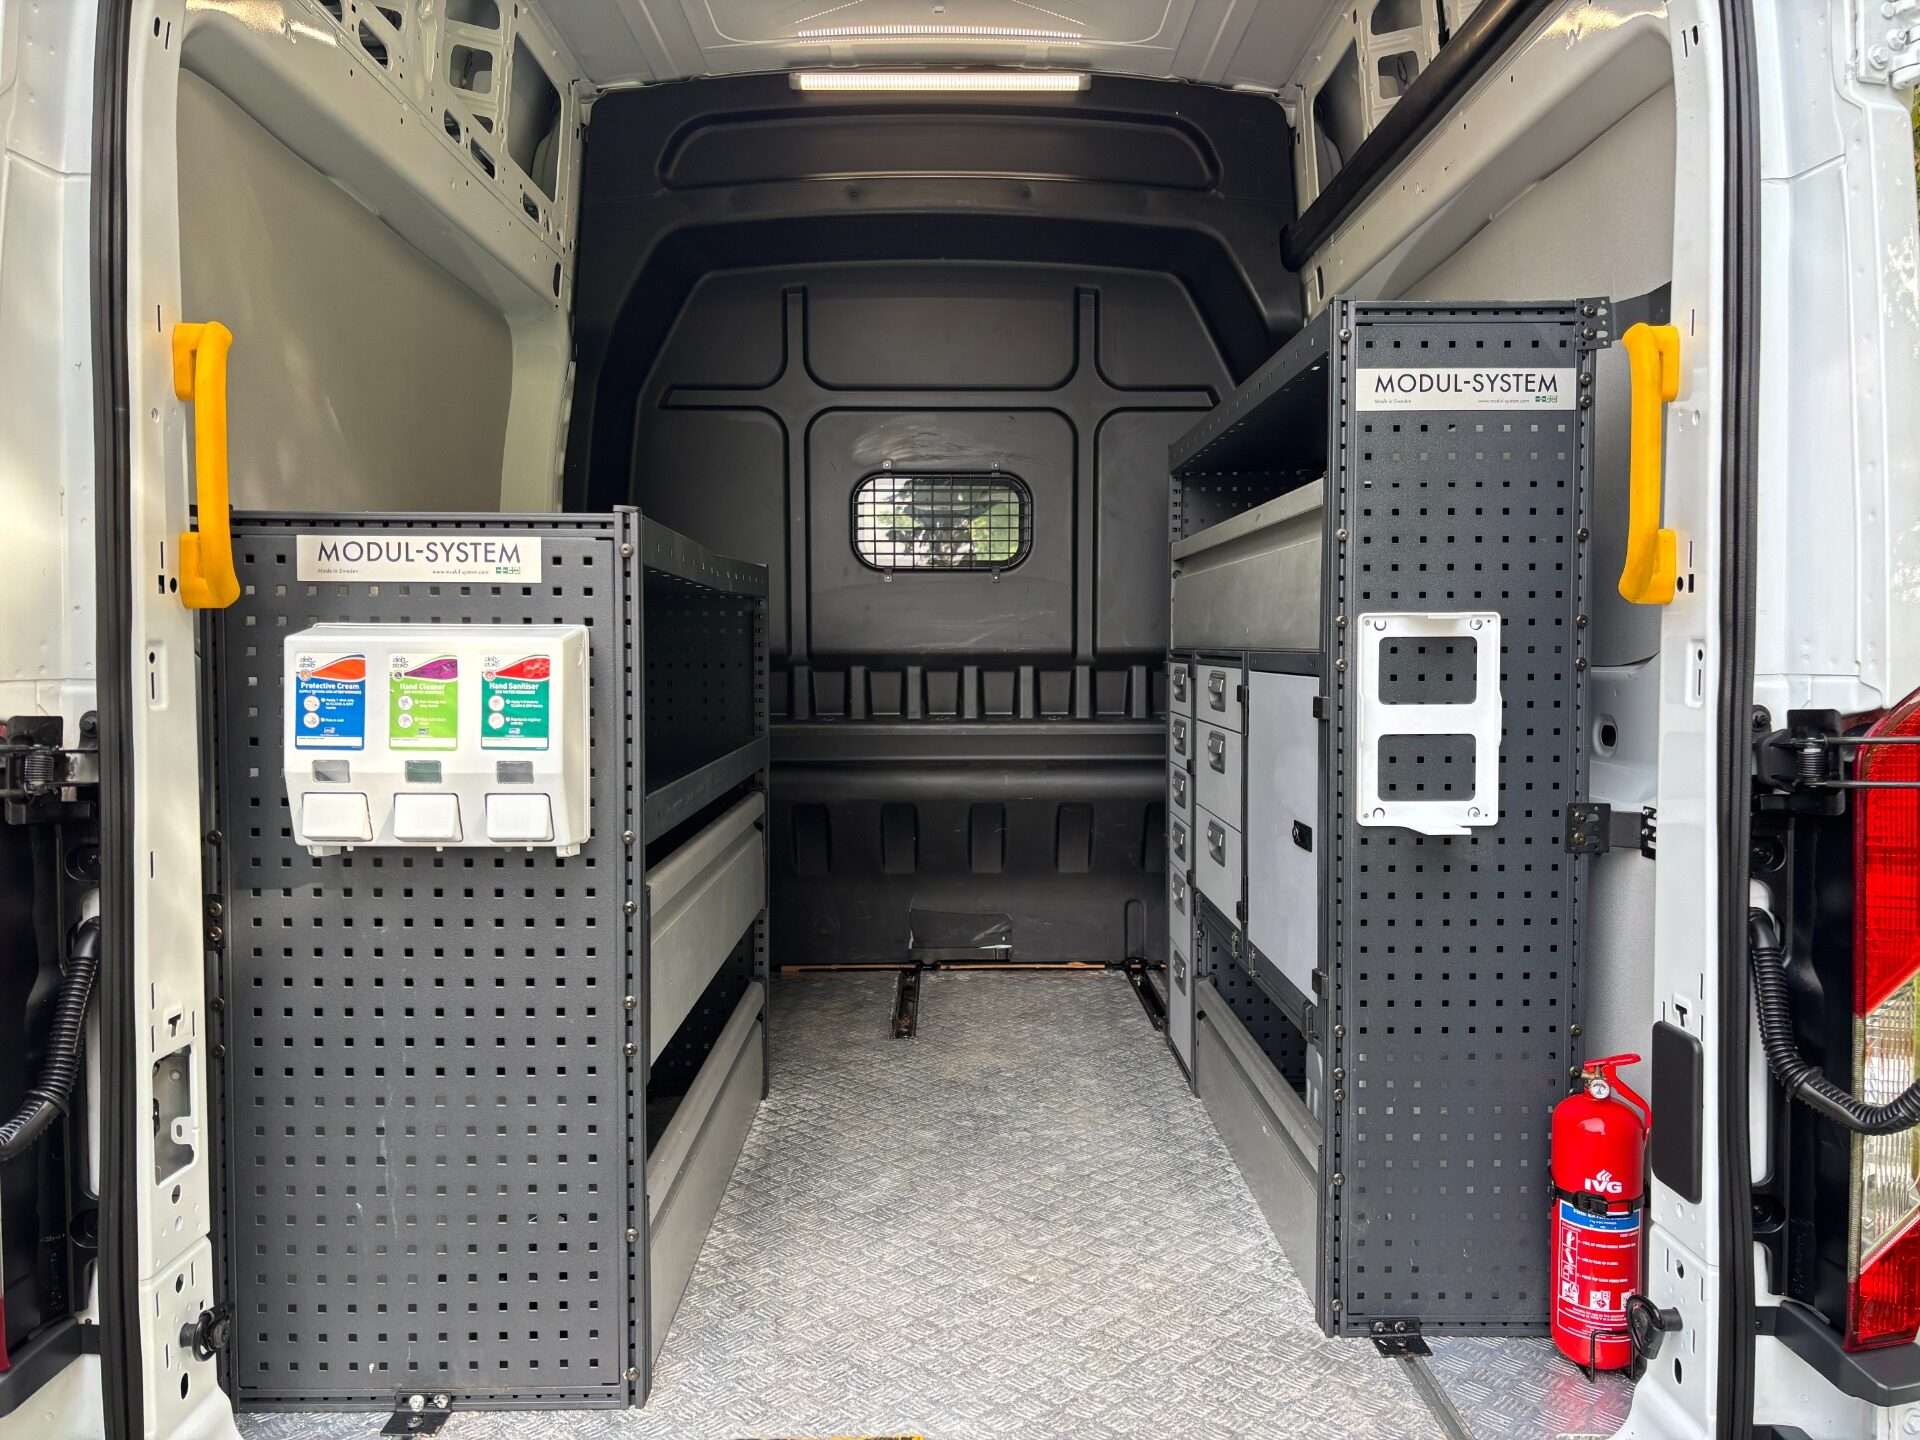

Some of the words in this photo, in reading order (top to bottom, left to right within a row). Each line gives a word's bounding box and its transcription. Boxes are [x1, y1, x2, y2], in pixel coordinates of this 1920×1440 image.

[1375, 373, 1558, 393] MODUL-SYSTEM
[317, 541, 521, 563] MODUL-SYSTEM
[300, 682, 336, 690] Protective
[336, 682, 360, 690] Cream
[400, 683, 418, 691] Hand
[419, 683, 446, 691] Cleaner
[489, 682, 508, 690] Hand
[1584, 1177, 1623, 1194] IVG
